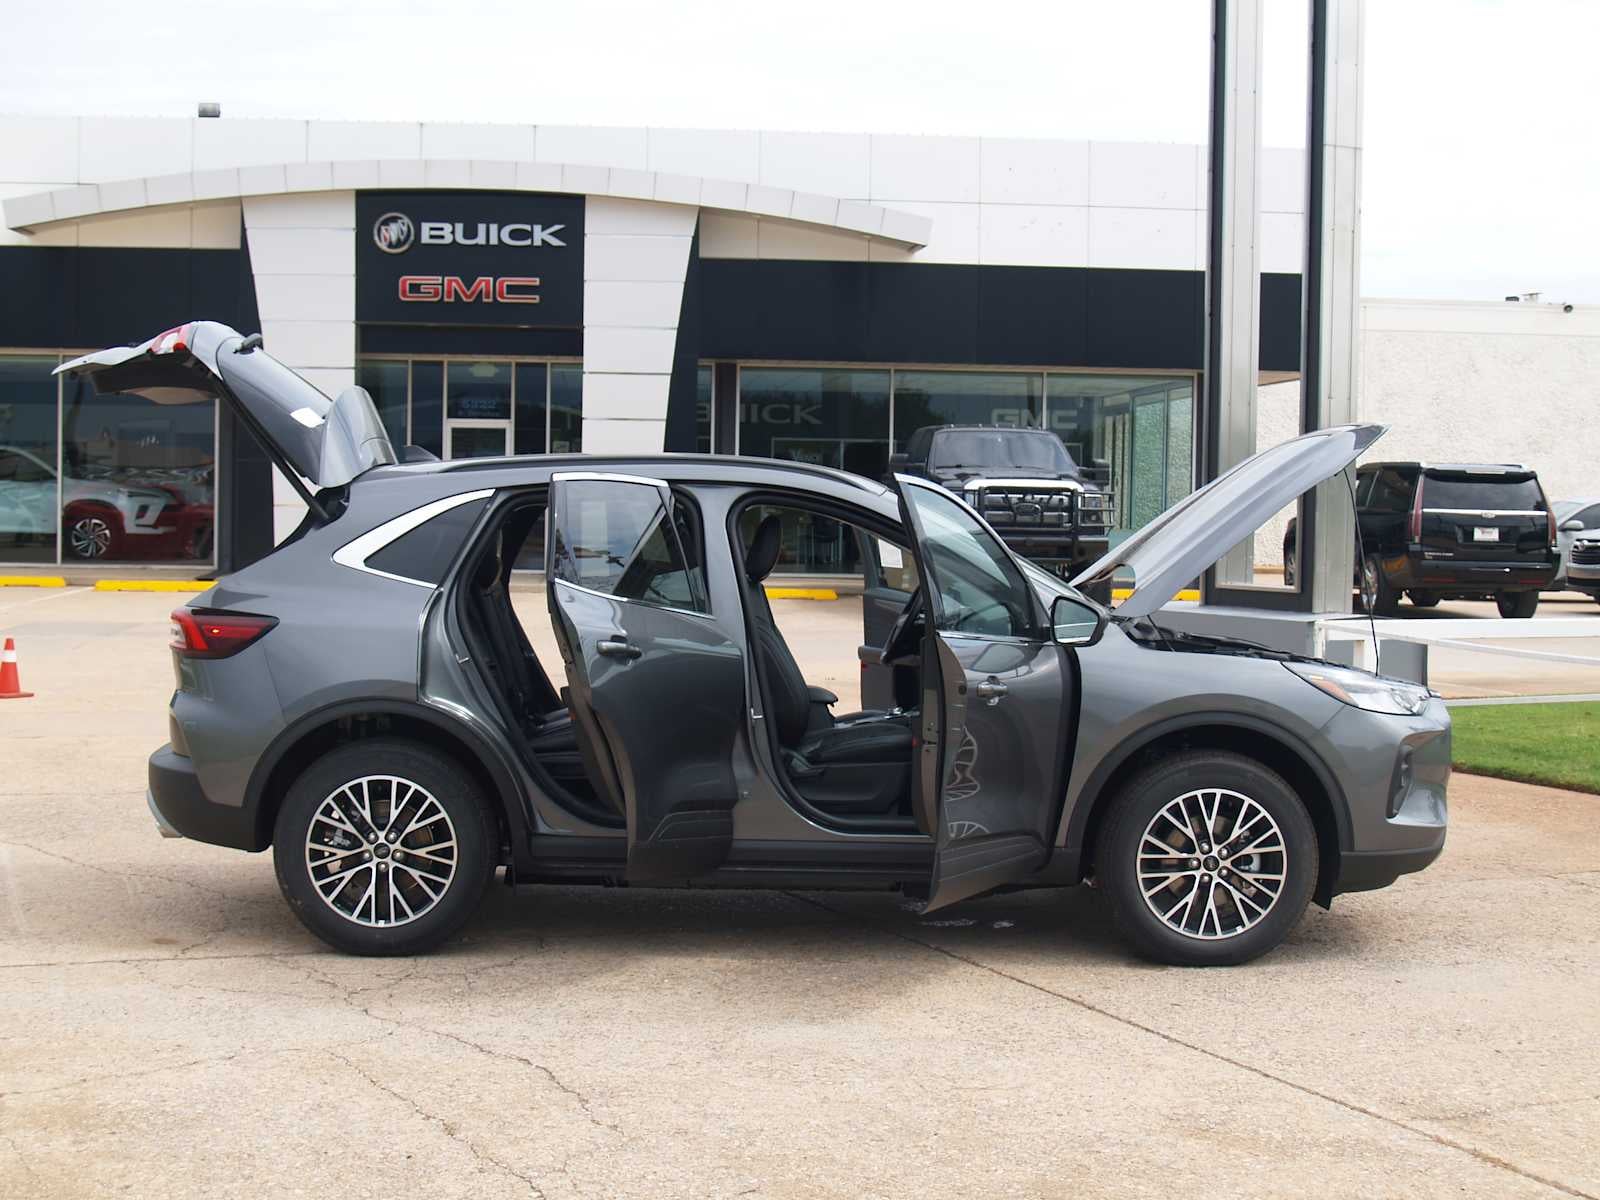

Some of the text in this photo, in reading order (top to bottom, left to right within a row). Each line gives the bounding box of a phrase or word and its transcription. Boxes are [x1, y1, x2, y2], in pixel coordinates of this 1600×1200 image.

[420, 221, 567, 247] BUICK
[398, 275, 541, 304] GMC
[991, 408, 1078, 429] GMC
